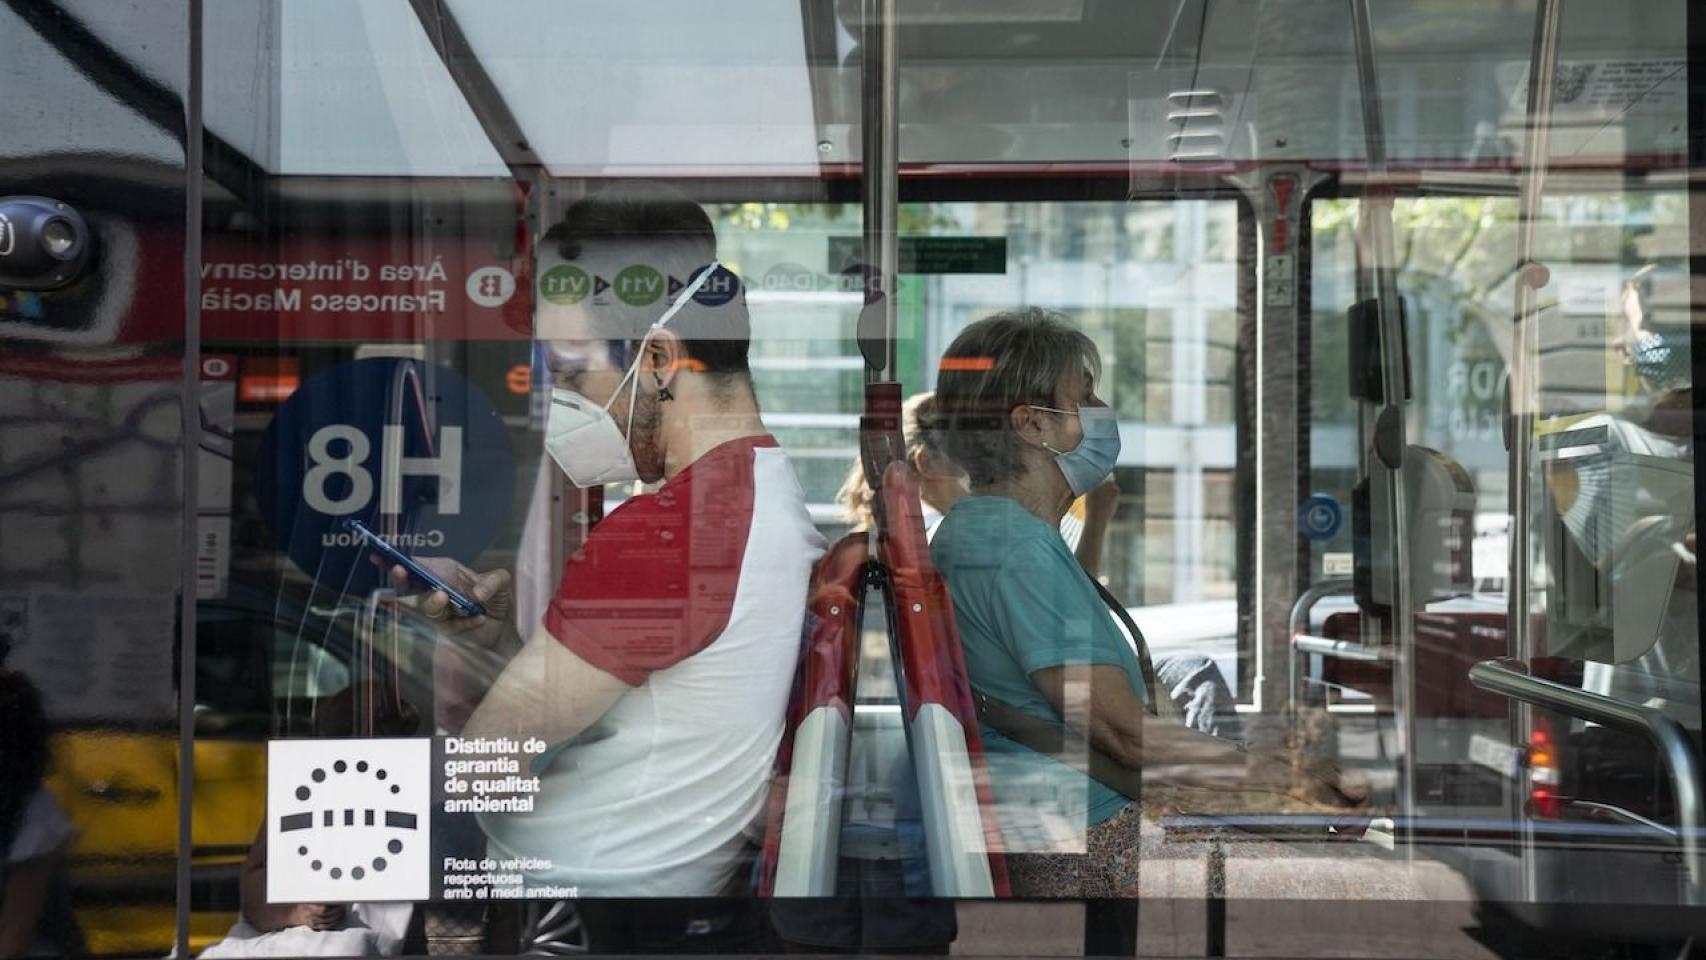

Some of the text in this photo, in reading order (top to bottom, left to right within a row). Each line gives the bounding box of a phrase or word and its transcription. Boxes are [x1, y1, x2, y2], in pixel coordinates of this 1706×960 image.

[444, 737, 547, 754] Distintiu de
[444, 757, 519, 777] garantia
[444, 776, 541, 797] de qualitat
[443, 795, 534, 813] ambiental
[443, 857, 553, 871] Flota de vehicles
[443, 872, 524, 888] respectuosa
[443, 885, 578, 899] amb el medi ambient
